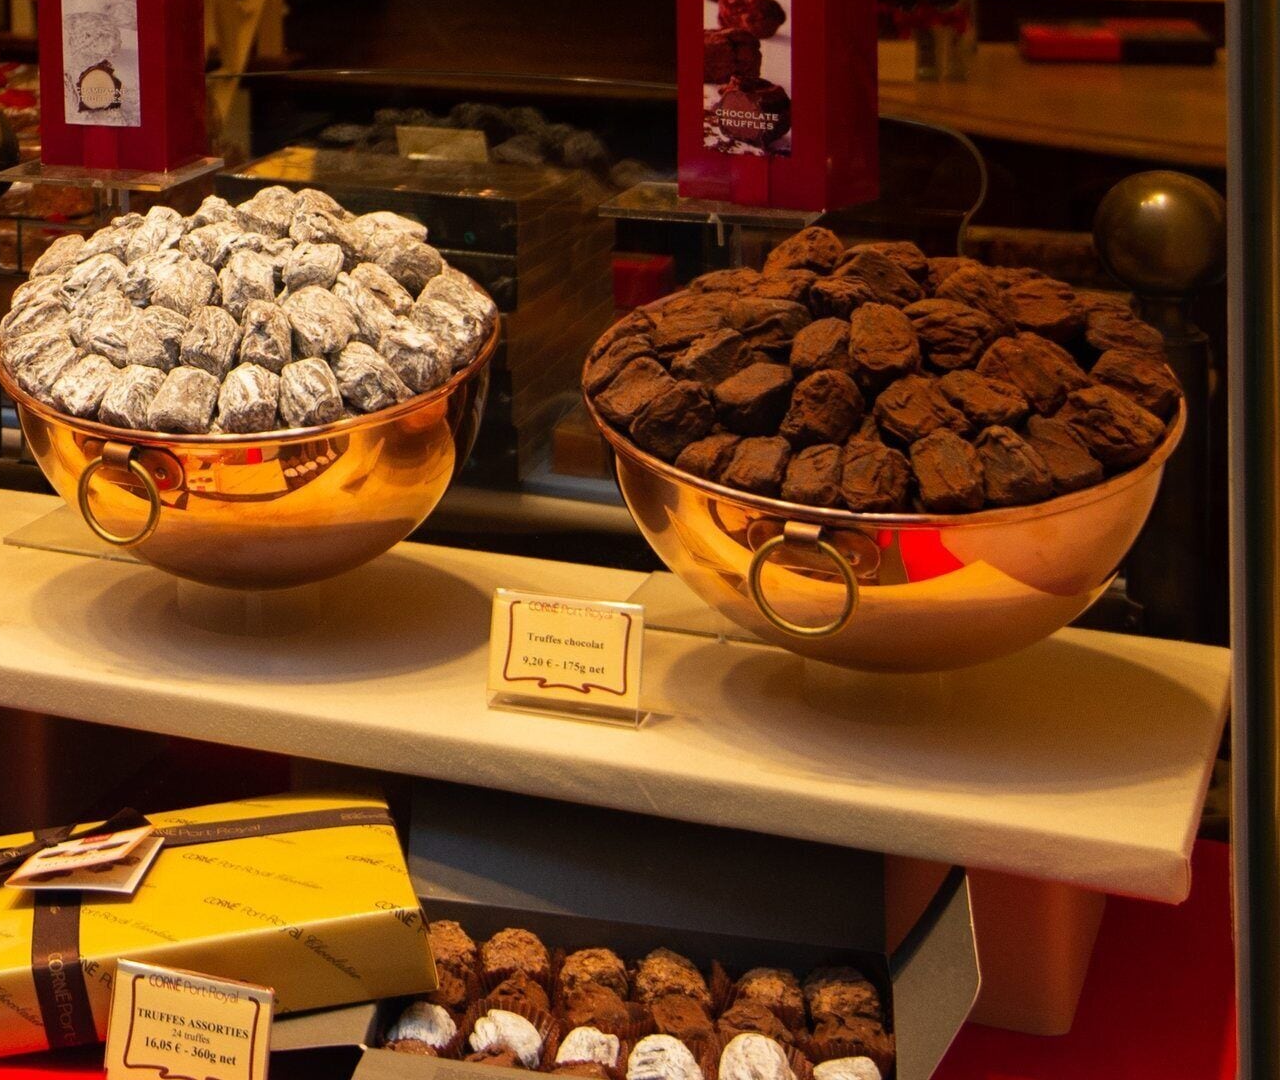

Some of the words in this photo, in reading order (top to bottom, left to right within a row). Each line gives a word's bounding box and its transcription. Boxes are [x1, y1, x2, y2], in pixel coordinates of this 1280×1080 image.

[715, 108, 779, 122] CHOCOLATE
[717, 117, 774, 131] TRUFFLES
[527, 632, 562, 645] Truffes
[564, 637, 604, 650] chocolat
[523, 655, 543, 666] 9,20
[546, 658, 552, 668] €
[562, 660, 586, 674] 175g
[589, 665, 605, 674] net
[178, 824, 261, 837] Port-Royal
[149, 973, 183, 992] CORNÉ
[184, 978, 239, 1005] Port-Royal
[137, 1007, 185, 1027] TRUFFES
[188, 1020, 249, 1040] ASSORTIES
[172, 1028, 183, 1038] 24
[184, 1030, 210, 1045] truffes
[145, 1036, 172, 1051] 16,05
[175, 1042, 181, 1053] €
[191, 1045, 216, 1064] 360g
[219, 1053, 236, 1066] net
